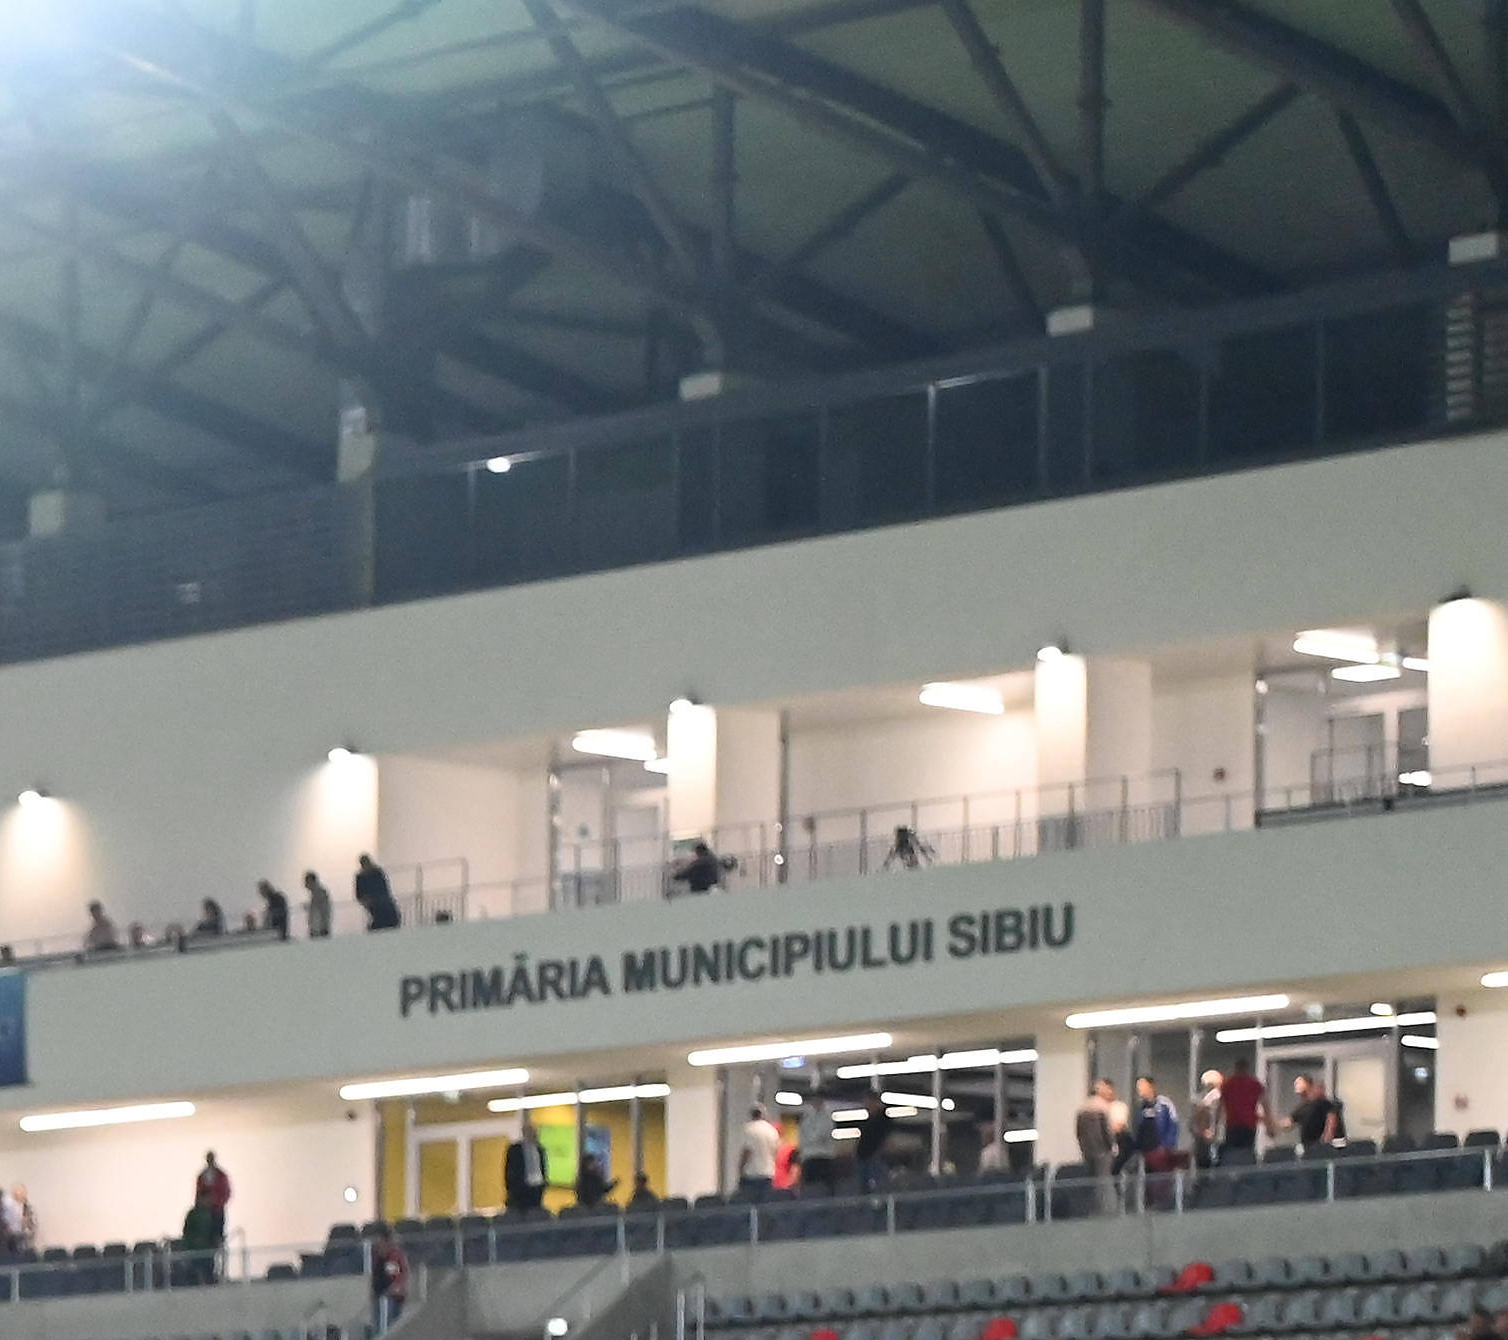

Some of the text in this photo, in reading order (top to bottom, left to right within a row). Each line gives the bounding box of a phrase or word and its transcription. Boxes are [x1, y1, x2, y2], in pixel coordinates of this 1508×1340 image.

[399, 901, 1077, 1018] PRIMĂRIA MUNICIPIULUI SIBIU
